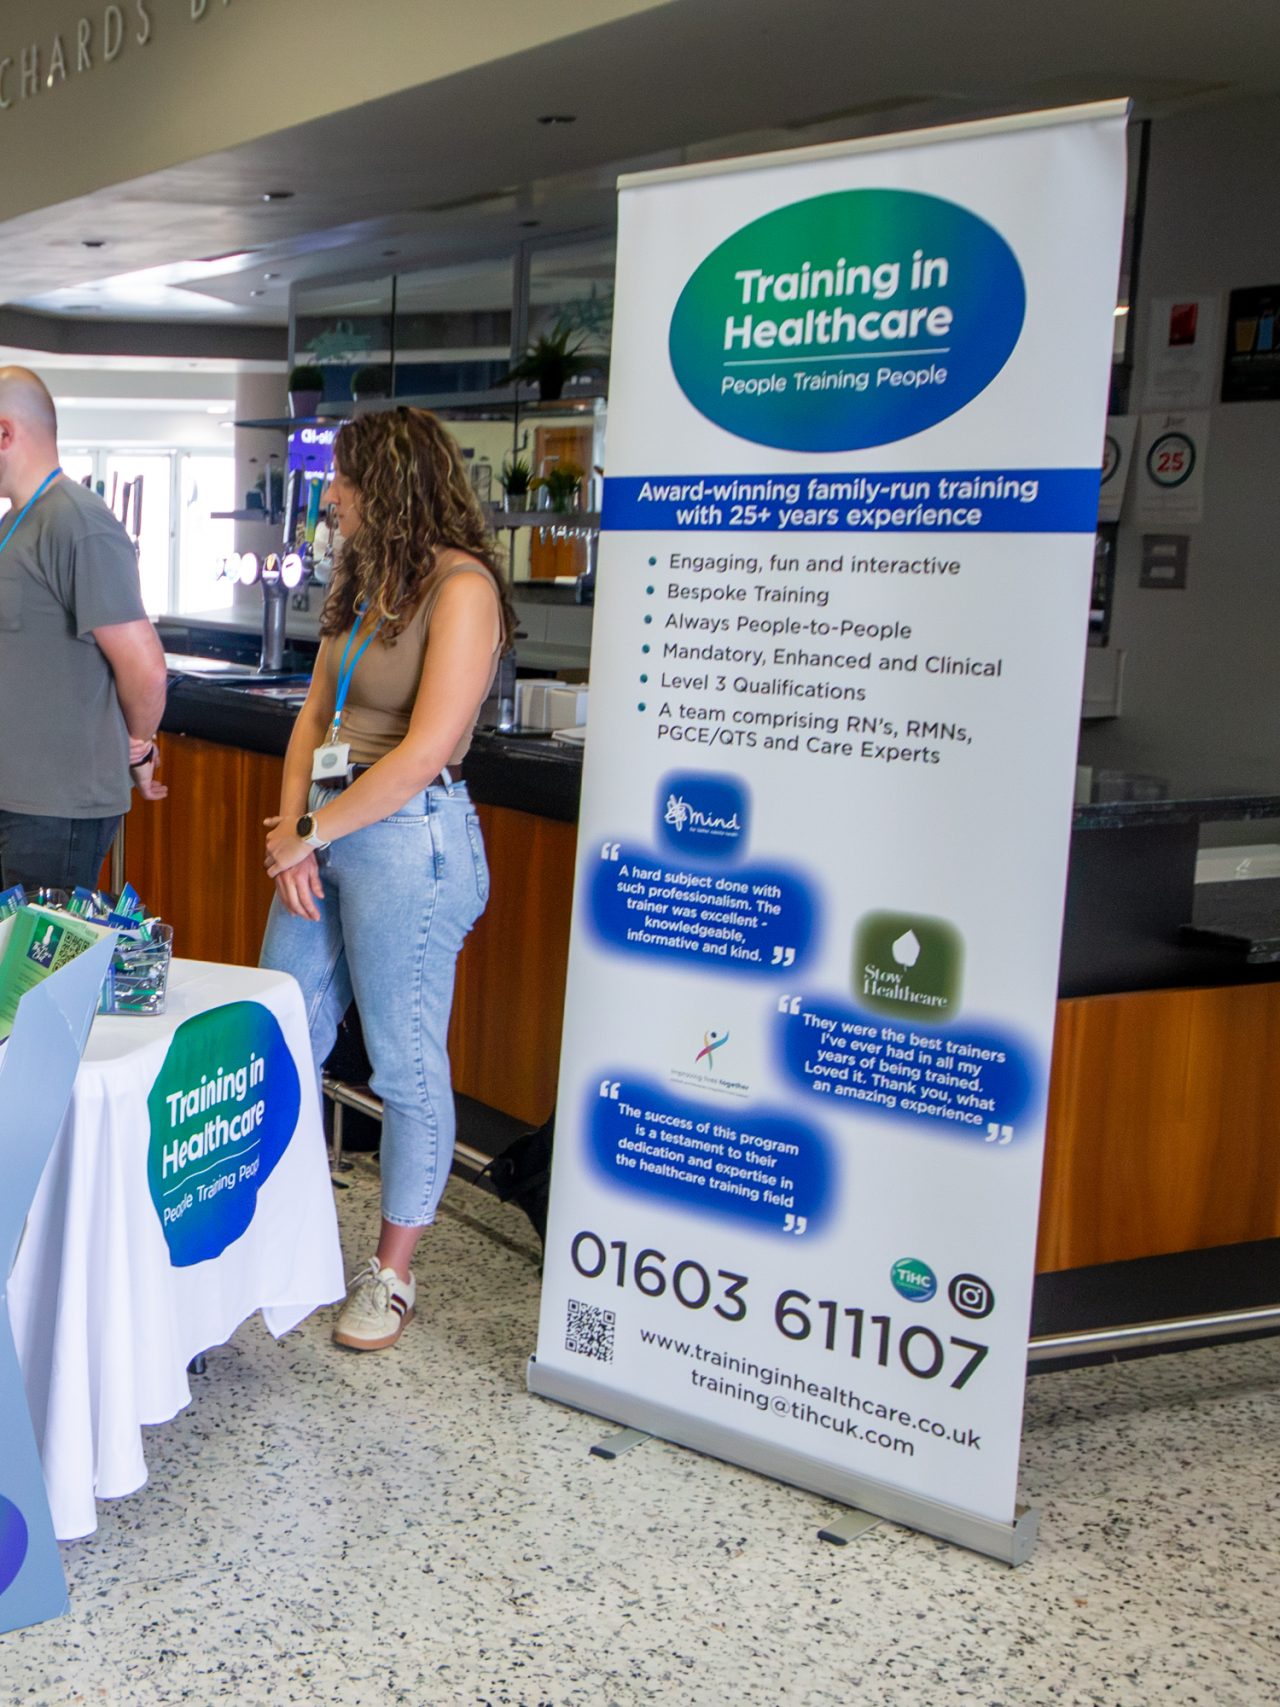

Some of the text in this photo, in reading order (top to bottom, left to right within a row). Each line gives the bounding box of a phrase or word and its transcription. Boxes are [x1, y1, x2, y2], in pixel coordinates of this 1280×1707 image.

[734, 249, 948, 304] Training in
[723, 305, 953, 350] Healthcare
[720, 363, 947, 395] People Training People
[1157, 451, 1184, 472] 25
[637, 477, 1038, 504] Award-winning family-run training
[675, 503, 982, 529] with 25+ years experience
[669, 552, 960, 575] Engaging, fun and interactive
[667, 582, 829, 607] Bespoke Training
[664, 612, 912, 641] Always People-to-People
[662, 642, 1002, 677] Mandatory, Enhanced and Clinical
[660, 672, 866, 701] Level 3 Qualifications
[657, 723, 940, 764] PGCE/QTS and Care Experts
[658, 701, 972, 745] A team comprising RN's, RMNs,
[690, 811, 741, 830] mind
[616, 881, 781, 915] such professionalism. The
[618, 864, 781, 898] A hard subject done with
[626, 897, 669, 914] trainer
[671, 905, 697, 918] was
[699, 909, 758, 928] excellent
[644, 914, 746, 944] knowledgeable,
[626, 928, 762, 961] informative and kind.
[862, 978, 947, 1006] Healthcare
[863, 964, 901, 983] Stow
[802, 1012, 1005, 1063] They were the best trainers
[820, 1031, 982, 1077] I've ever had in all my
[166, 1053, 264, 1128] Training in
[804, 1060, 995, 1111] Loved it. Thank you, what
[817, 1049, 983, 1092] years of being trained.
[811, 1079, 983, 1125] an amazing experience
[162, 1098, 265, 1179] Healthcare
[617, 1102, 799, 1155] The success of this program
[635, 1122, 777, 1168] is a testament to their
[615, 1152, 794, 1208] the healthcare training field
[617, 1136, 793, 1190] dedication and expertise in
[164, 1193, 193, 1227] People
[197, 1173, 236, 1202] Training
[897, 1269, 931, 1288] TiHC
[570, 1230, 989, 1390] 01603 611107
[639, 1329, 980, 1450] www.traininginhealthcare.co.uk
[691, 1368, 914, 1456] training@tihcuk.com
